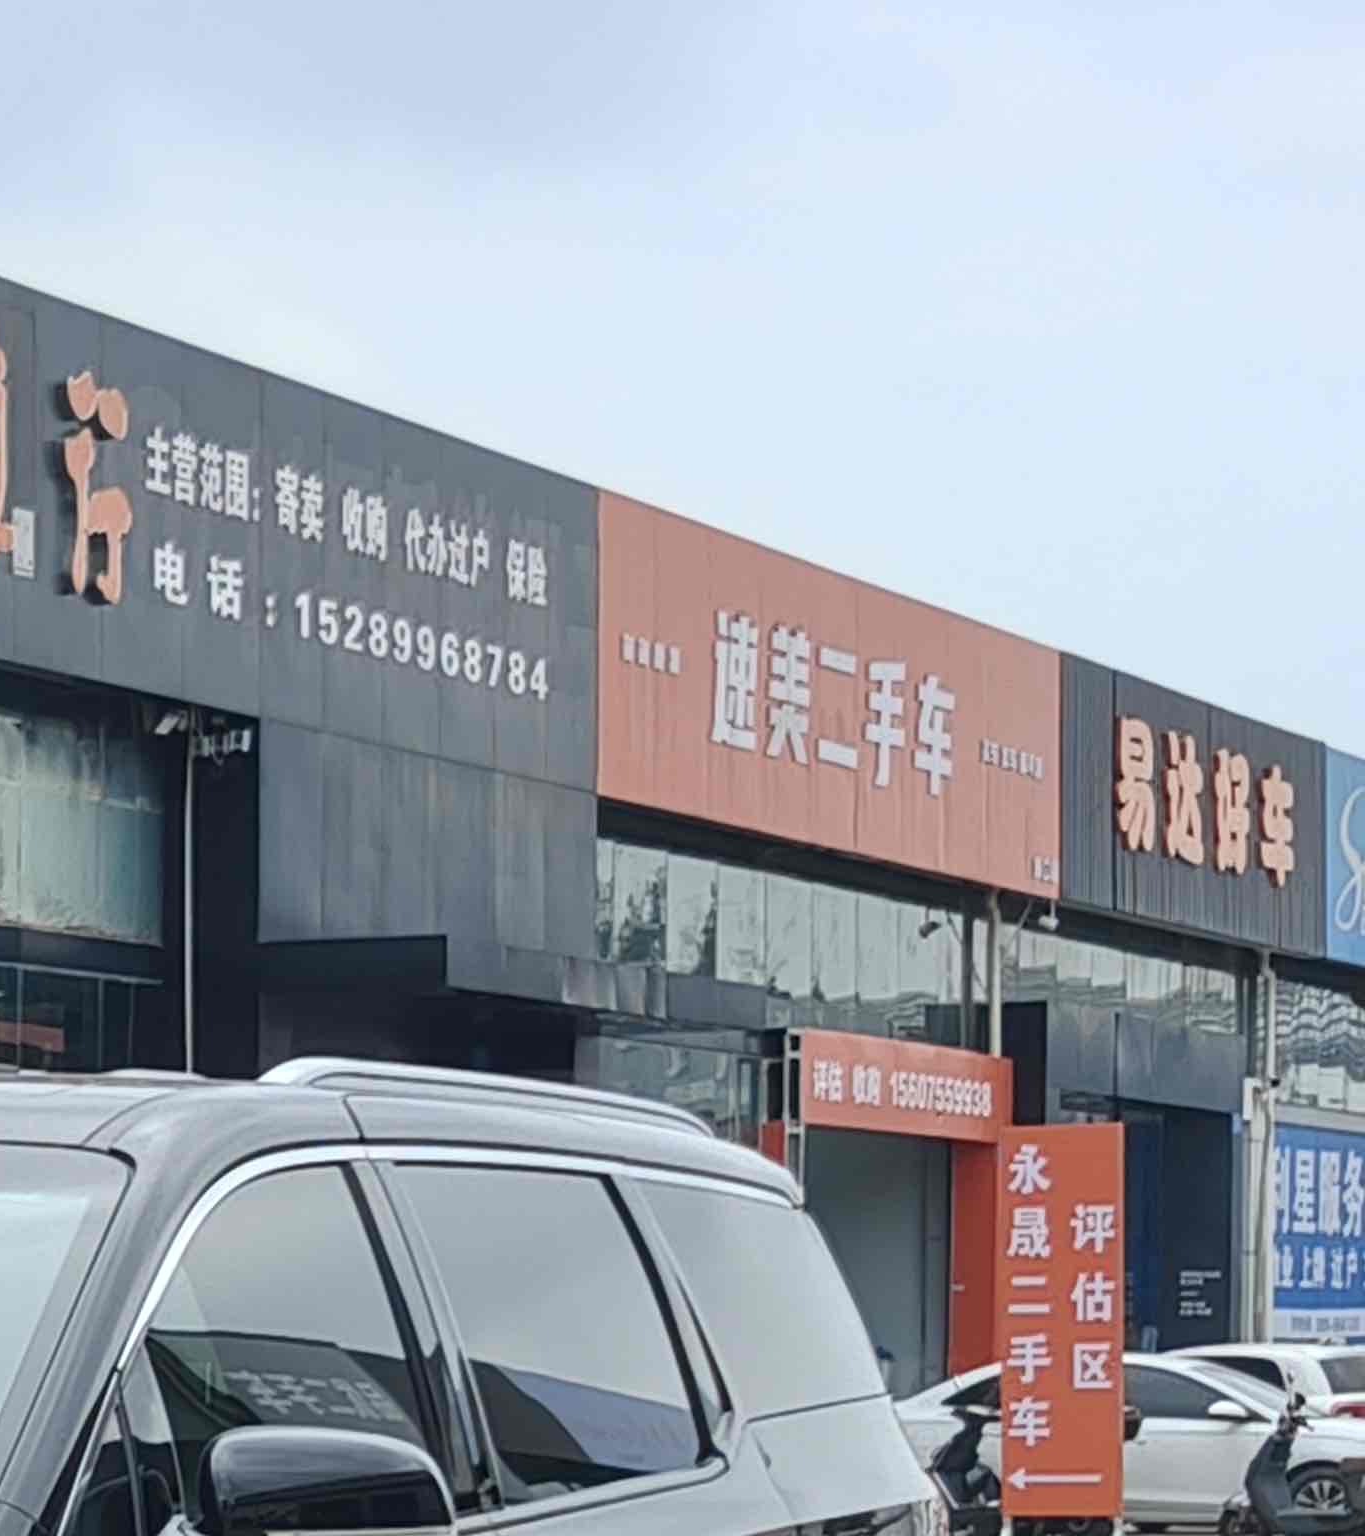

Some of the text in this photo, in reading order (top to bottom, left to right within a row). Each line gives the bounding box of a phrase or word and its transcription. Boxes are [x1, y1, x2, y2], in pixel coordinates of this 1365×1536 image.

[342, 486, 388, 562] 收购
[405, 507, 490, 588] 代办过户
[506, 539, 548, 606] 保险
[1116, 716, 1295, 888] 易达好车
[1006, 1143, 1053, 1448] 永晟二手车
[1070, 1203, 1116, 1390] 评估区
